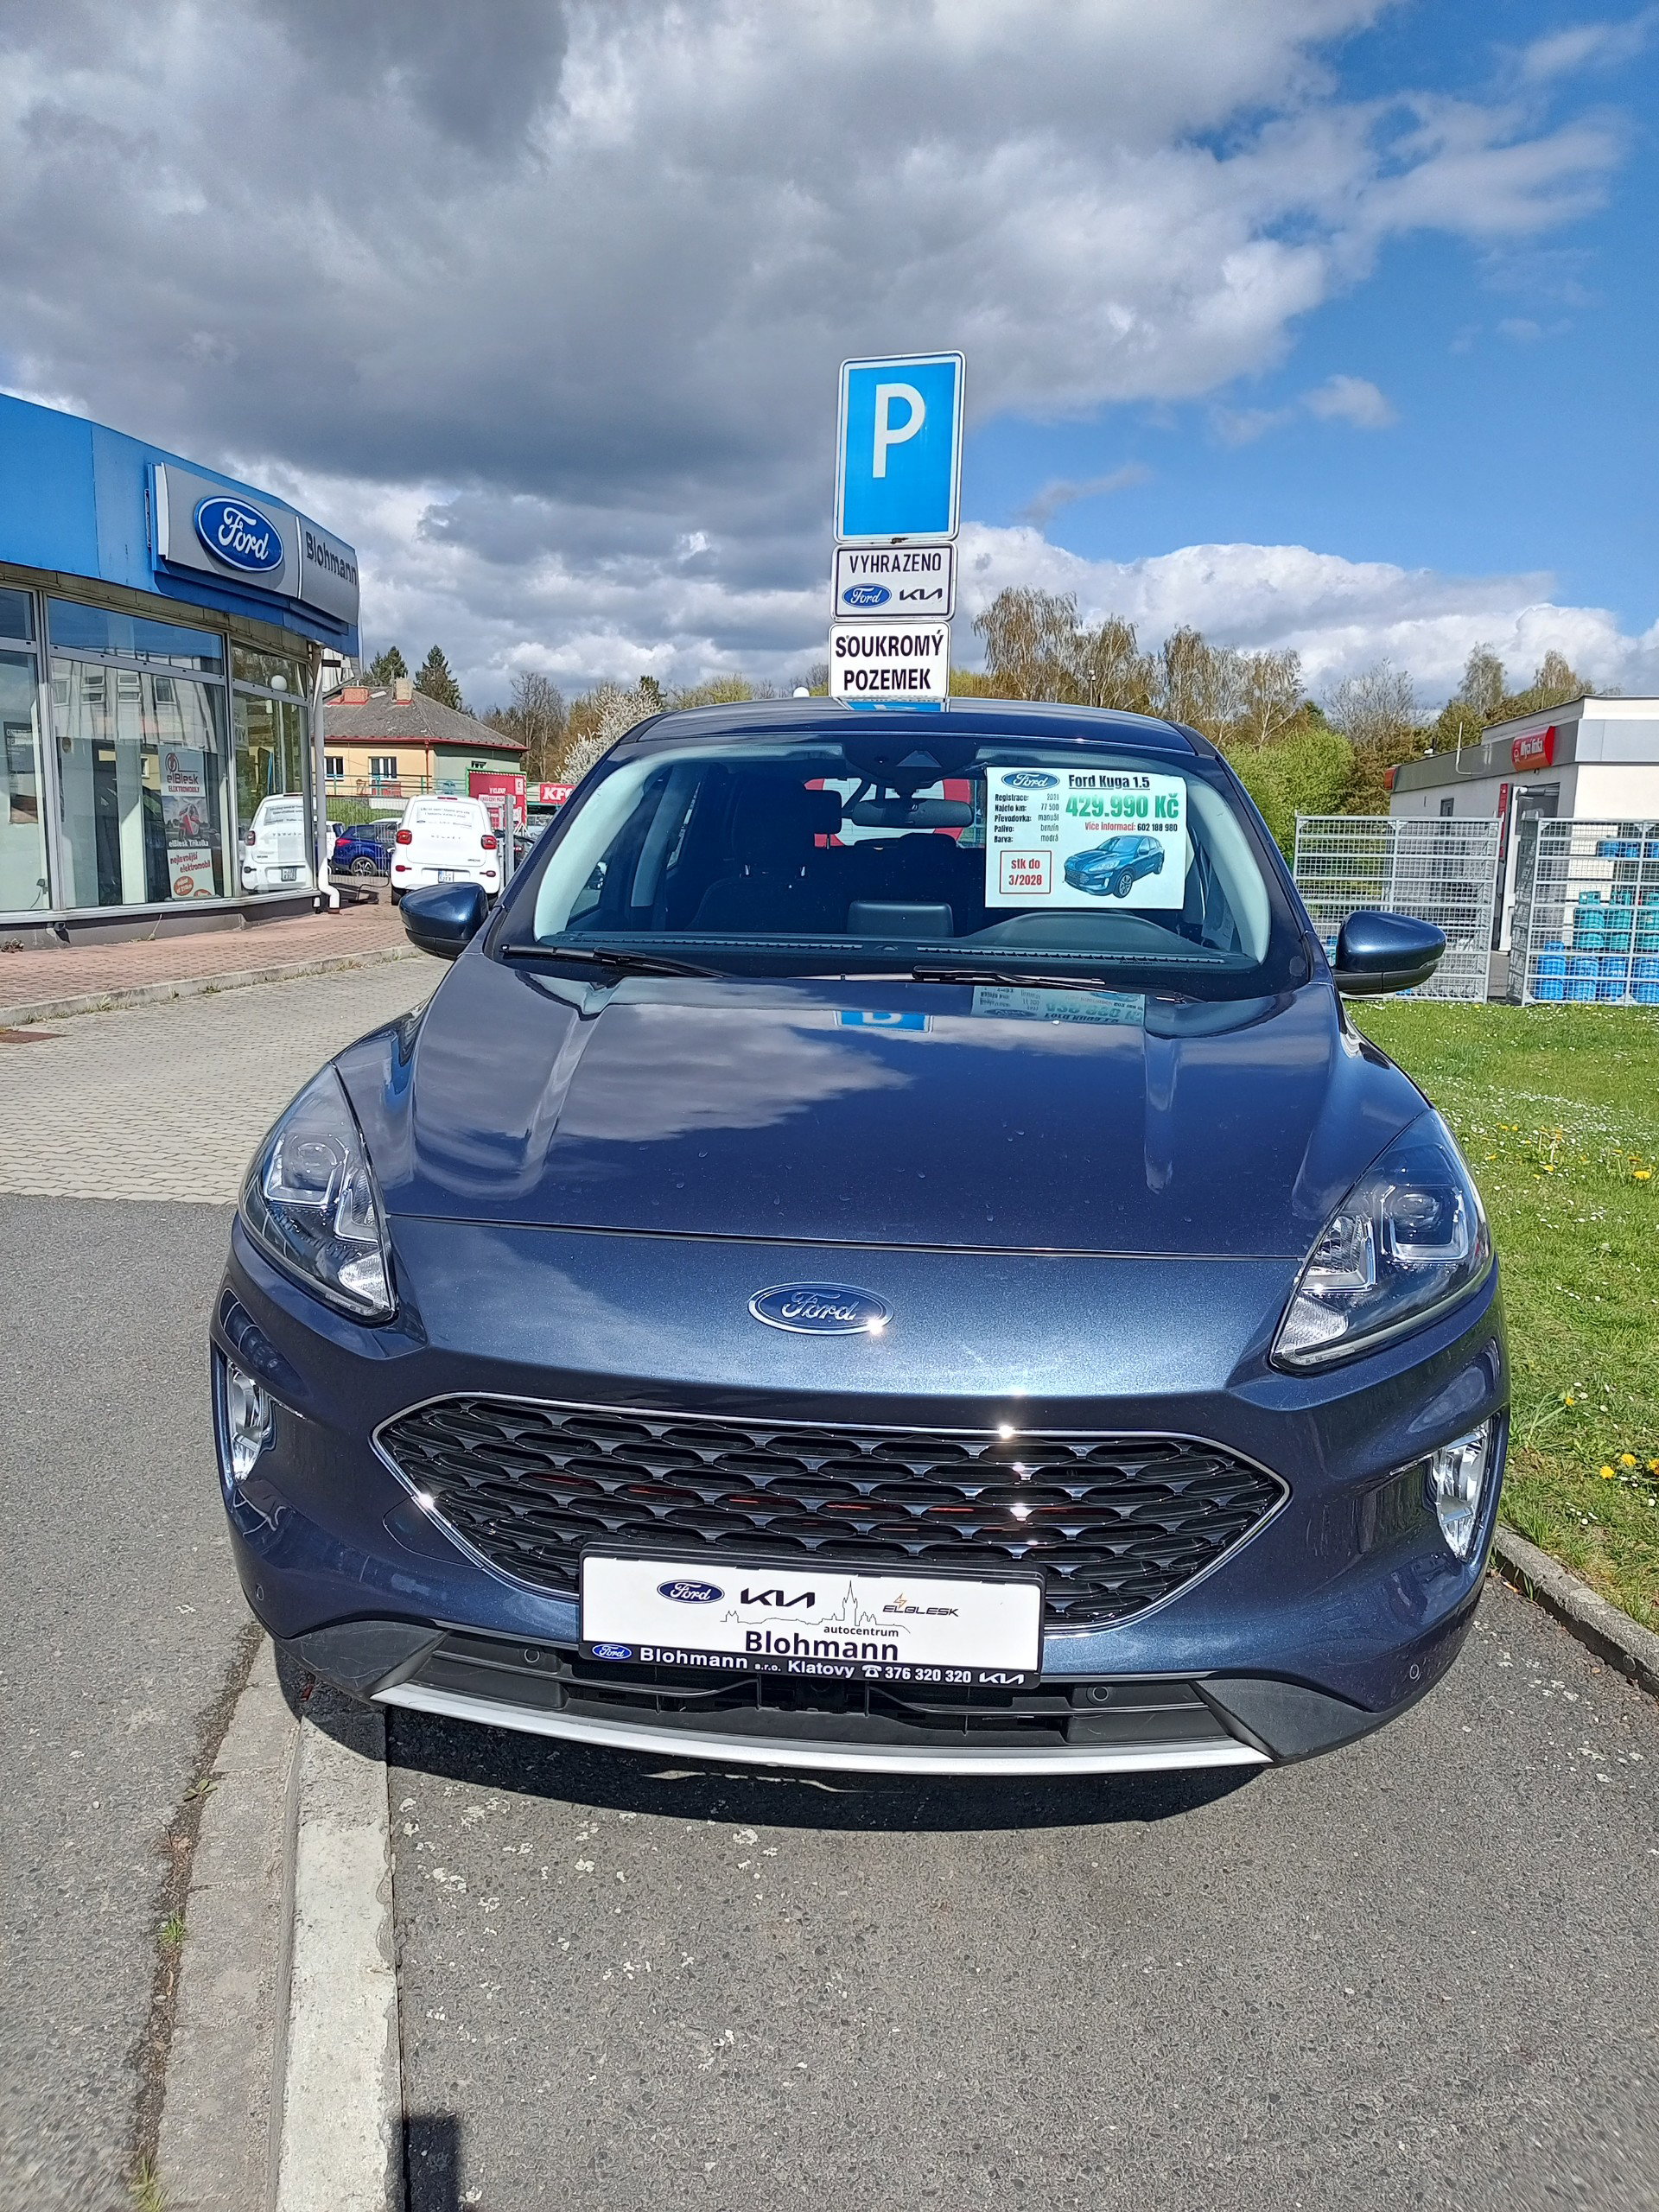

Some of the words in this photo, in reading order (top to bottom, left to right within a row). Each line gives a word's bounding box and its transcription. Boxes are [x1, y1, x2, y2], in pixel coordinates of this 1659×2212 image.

[872, 382, 925, 478] P
[218, 506, 270, 560] Ford
[305, 531, 358, 586] Blohmann
[849, 552, 942, 574] VYHRAZENO
[850, 585, 882, 604] Ford
[899, 587, 943, 602] KIA
[835, 629, 944, 658] SOUKROMÝ
[843, 668, 931, 691] POZEMEK
[1013, 772, 1049, 787] Ford
[1068, 774, 1096, 787] Ford
[1099, 775, 1129, 789] Kuga
[1133, 776, 1150, 788] 1.5
[995, 793, 1029, 802] Registrace:
[1065, 794, 1148, 818] 429.990
[1154, 792, 1179, 818] Kč
[994, 824, 1014, 833] Palivo:
[1085, 822, 1099, 830] Více
[1101, 822, 1136, 831] informací:
[1165, 823, 1178, 832] 980
[1011, 858, 1027, 869] stk
[1028, 858, 1040, 869] do
[1008, 874, 1042, 886] 3/2028
[781, 1291, 859, 1321] Ford
[670, 1582, 712, 1601] Ford
[741, 1587, 816, 1609] KIA
[823, 1625, 899, 1637] autocentrum
[599, 1645, 625, 1658] Ford
[746, 1630, 899, 1661] Blohmann
[639, 1647, 748, 1669] Blohmann
[754, 1662, 782, 1672] s.r.o.
[787, 1660, 855, 1679] Klatovy
[885, 1667, 912, 1681] 376
[914, 1668, 941, 1682] 320
[944, 1669, 972, 1683] 320
[979, 1672, 1025, 1685] KIA
